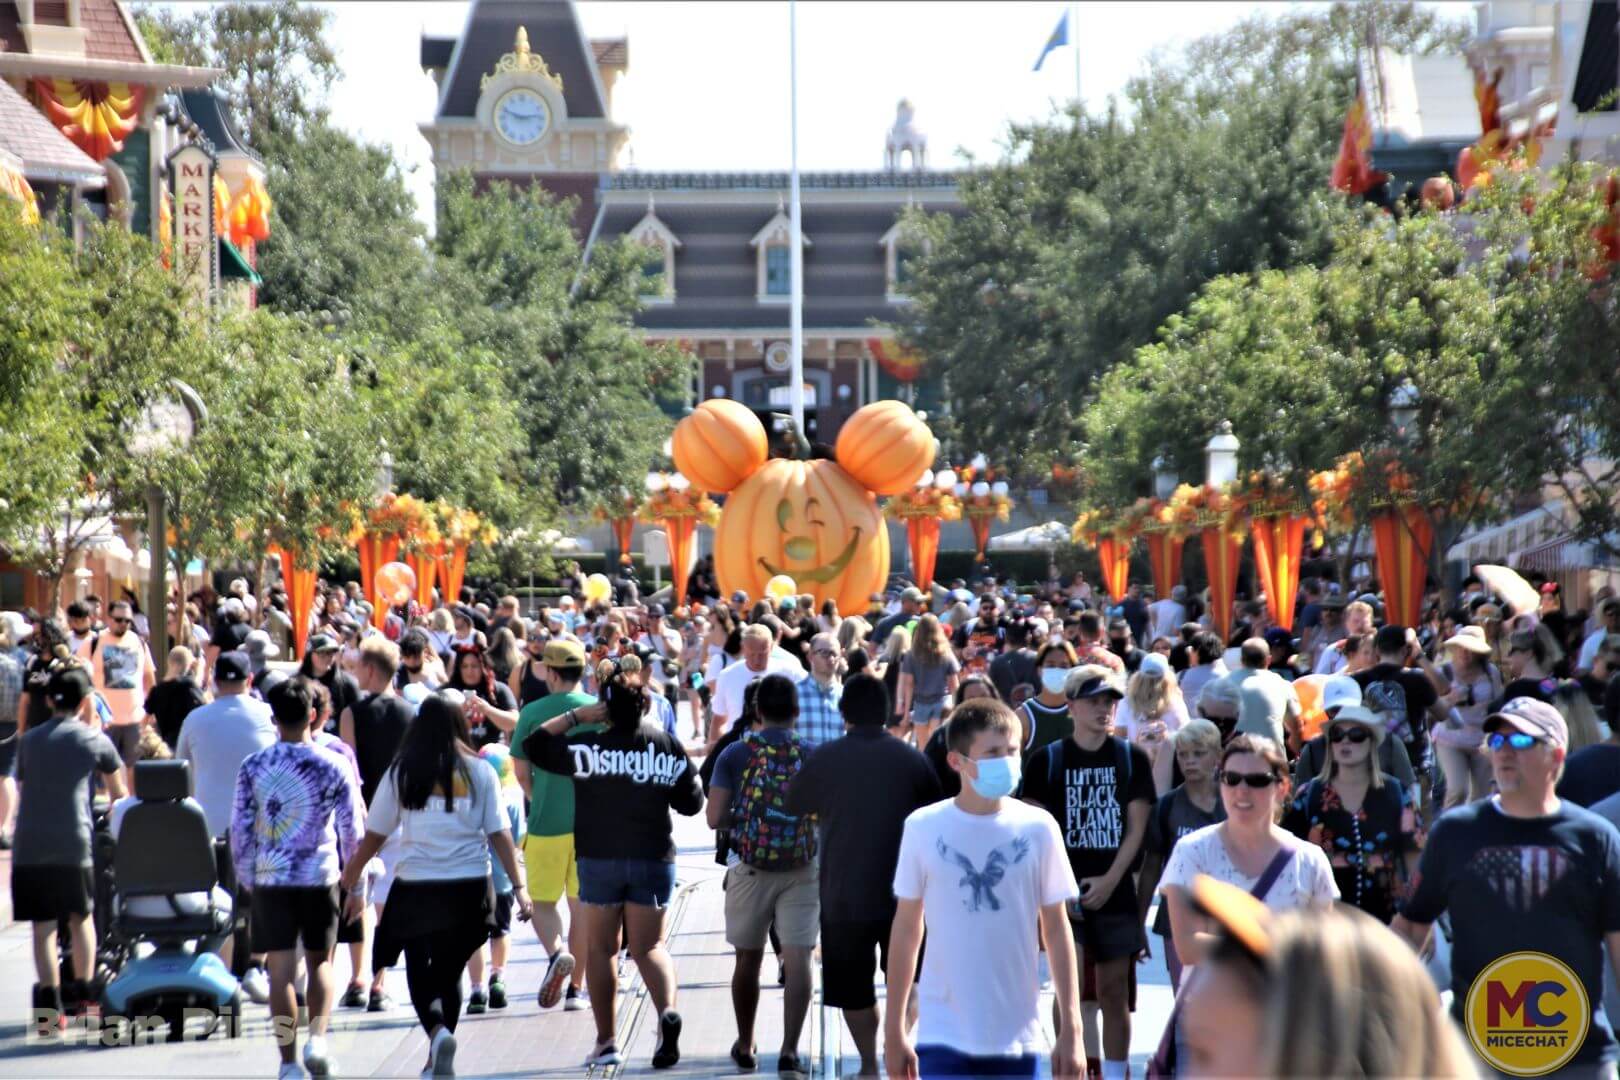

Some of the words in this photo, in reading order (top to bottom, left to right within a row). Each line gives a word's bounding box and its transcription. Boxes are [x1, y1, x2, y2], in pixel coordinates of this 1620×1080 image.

[181, 163, 205, 257] MARKE
[1065, 768, 1070, 785] I
[1073, 768, 1091, 785] LIT
[1094, 766, 1117, 785] THE
[1066, 785, 1120, 808] BLACK
[1066, 807, 1122, 830] FLAME
[1066, 829, 1121, 849] CANDLE
